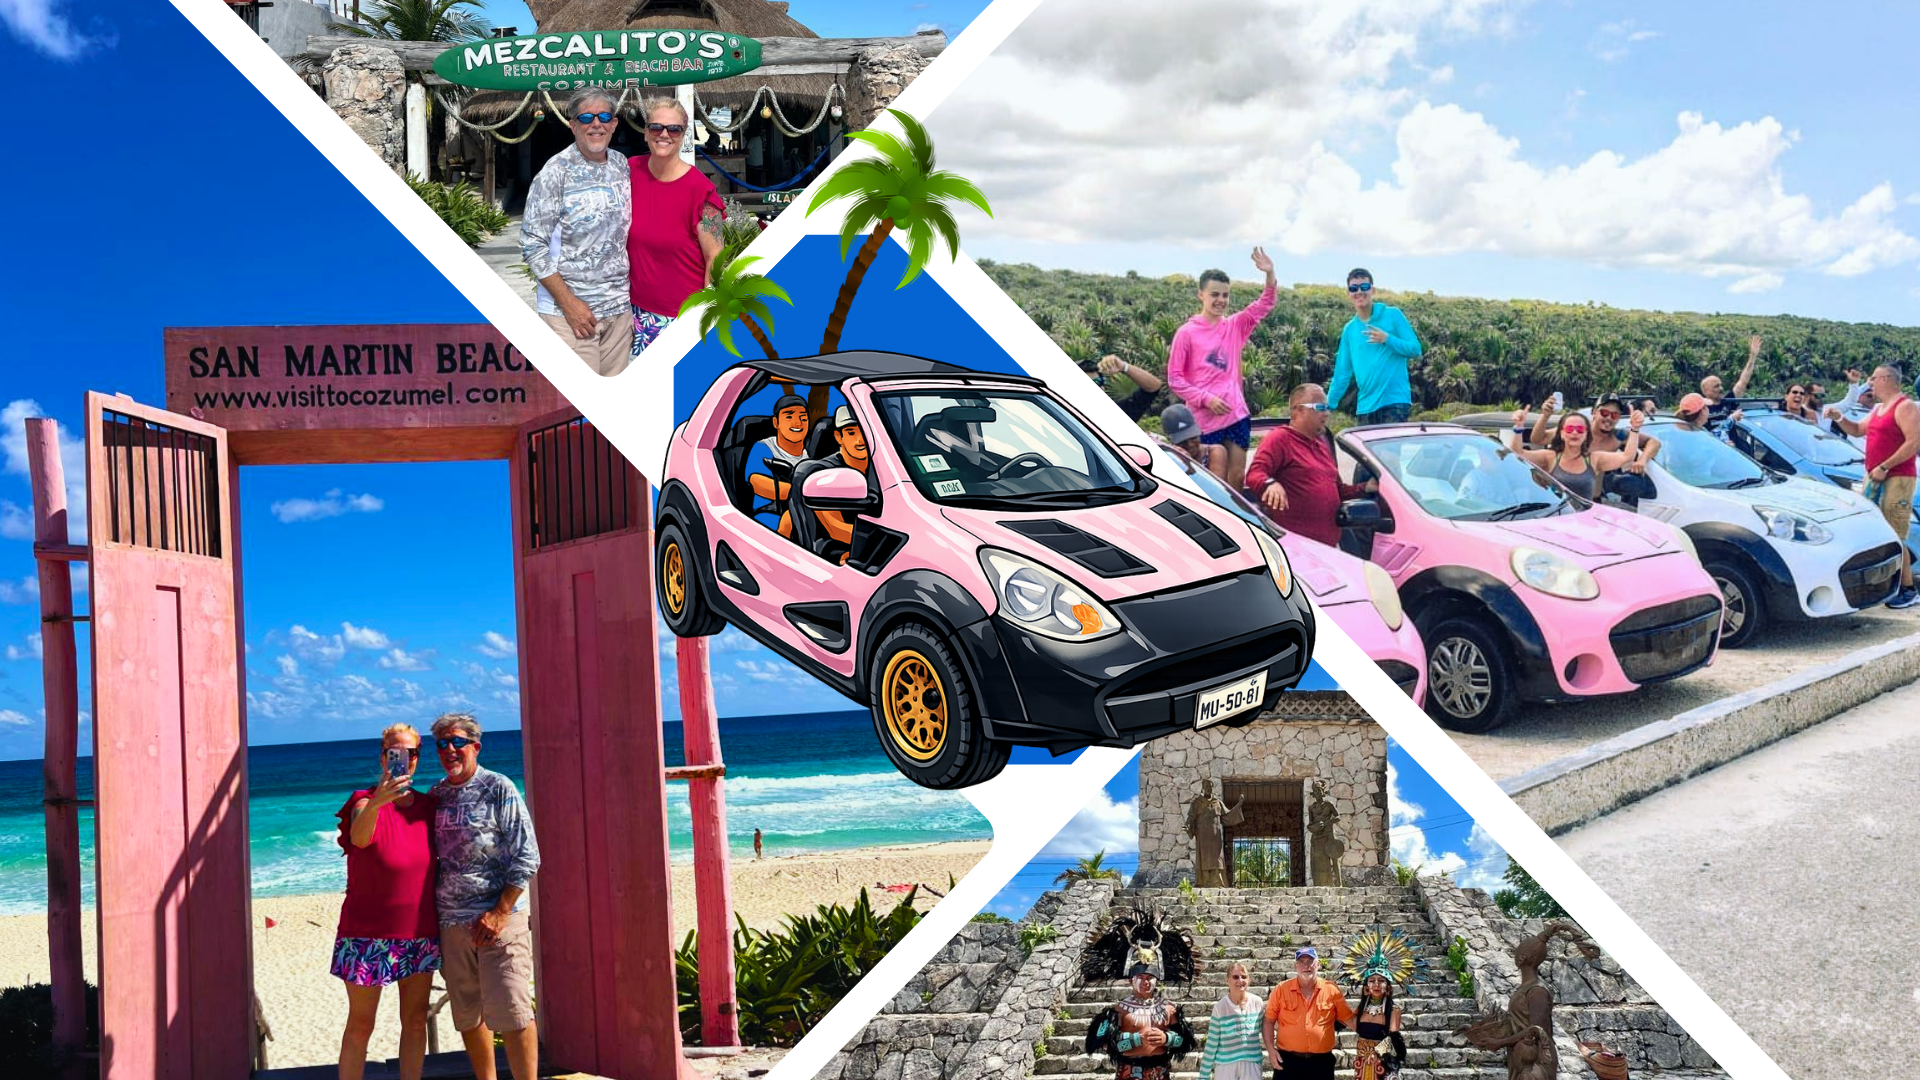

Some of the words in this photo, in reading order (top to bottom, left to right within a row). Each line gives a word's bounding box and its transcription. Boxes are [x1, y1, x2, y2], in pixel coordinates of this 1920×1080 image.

[463, 32, 726, 71] MEZCALITO'S
[503, 63, 595, 77] RESTAURANT
[624, 59, 669, 74] BEACH
[671, 58, 704, 71] BAR
[537, 78, 658, 91] COZUMEL
[189, 346, 259, 378] SAN
[284, 344, 413, 377] MARTIN
